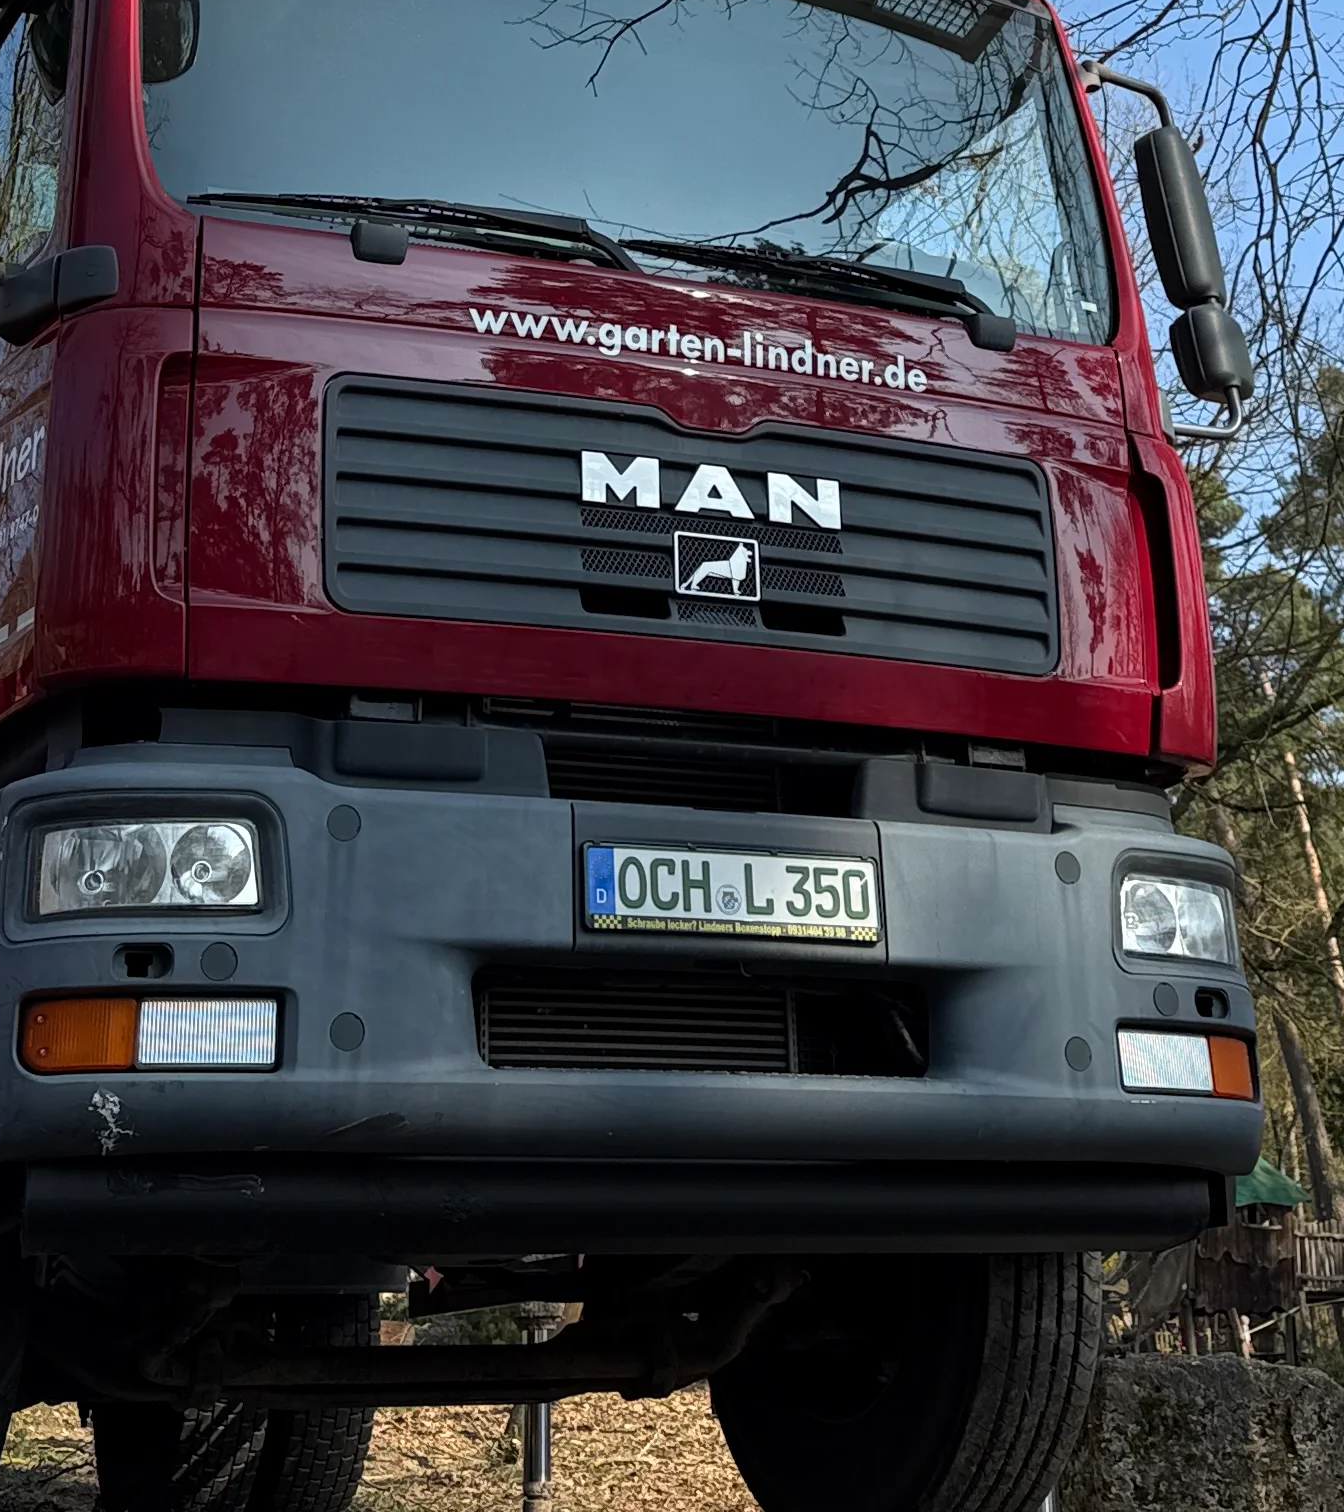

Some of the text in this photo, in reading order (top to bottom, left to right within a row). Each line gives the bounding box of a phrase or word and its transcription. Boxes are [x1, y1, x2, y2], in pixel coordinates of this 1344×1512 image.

[468, 307, 929, 393] www.garten-lindner.de
[580, 450, 842, 530] MAN
[596, 856, 870, 920] D OCH L 350
[627, 917, 666, 930] Schraube
[667, 918, 697, 931] locker?
